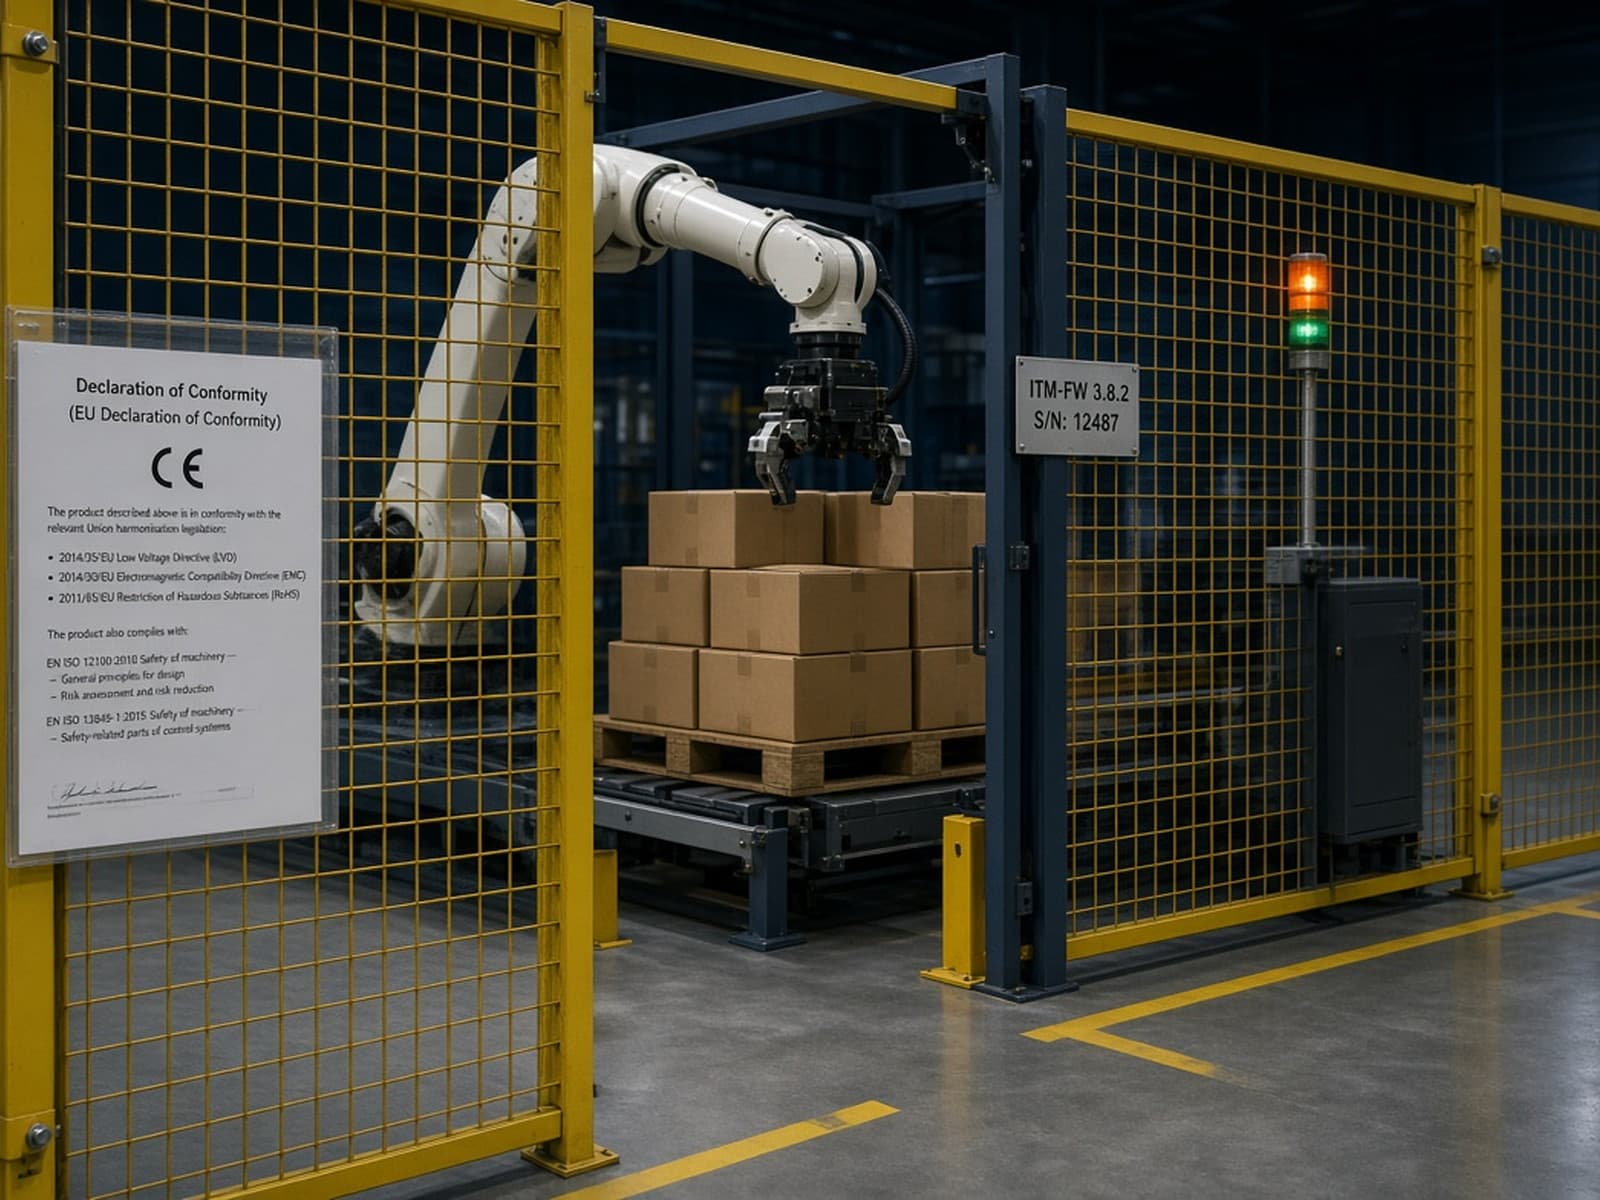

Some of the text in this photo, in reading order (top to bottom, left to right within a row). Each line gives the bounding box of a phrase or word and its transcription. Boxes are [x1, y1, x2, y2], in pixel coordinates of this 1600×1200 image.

[76, 377, 268, 406] Declaration of Conformity
[1030, 379, 1129, 402] ITM-FW 3.8.2
[69, 404, 282, 431] (EU Declaration of Conformity)
[1034, 410, 1119, 432] S/N: 12487
[152, 447, 204, 489] CE
[47, 505, 66, 517] The
[68, 507, 104, 519] product
[153, 508, 179, 518] above
[180, 508, 188, 518] is
[190, 508, 198, 518] in
[201, 508, 246, 520] conformity
[247, 509, 266, 519] with
[268, 509, 282, 519] the
[47, 523, 84, 533] relevant
[87, 523, 113, 533] Union
[117, 552, 135, 562] Low
[138, 552, 171, 565] Voltage
[173, 552, 210, 562] Directive
[117, 592, 164, 602] Restriction
[165, 592, 175, 601] of
[48, 629, 66, 639] The
[68, 628, 104, 641] product
[46, 657, 61, 668] EN
[63, 657, 80, 667] ISO
[140, 653, 168, 665] Safety
[171, 653, 180, 662] of
[181, 652, 226, 663] machinery
[61, 673, 96, 684] General
[142, 670, 154, 680] for
[157, 670, 185, 681] design
[61, 690, 80, 701] Risk
[136, 687, 153, 697] and
[173, 685, 215, 695] reduction
[46, 716, 60, 727] EN
[63, 715, 80, 725] ISO
[149, 709, 177, 722] Safety
[180, 707, 189, 717] of
[127, 728, 150, 739] parts
[152, 725, 161, 736] of
